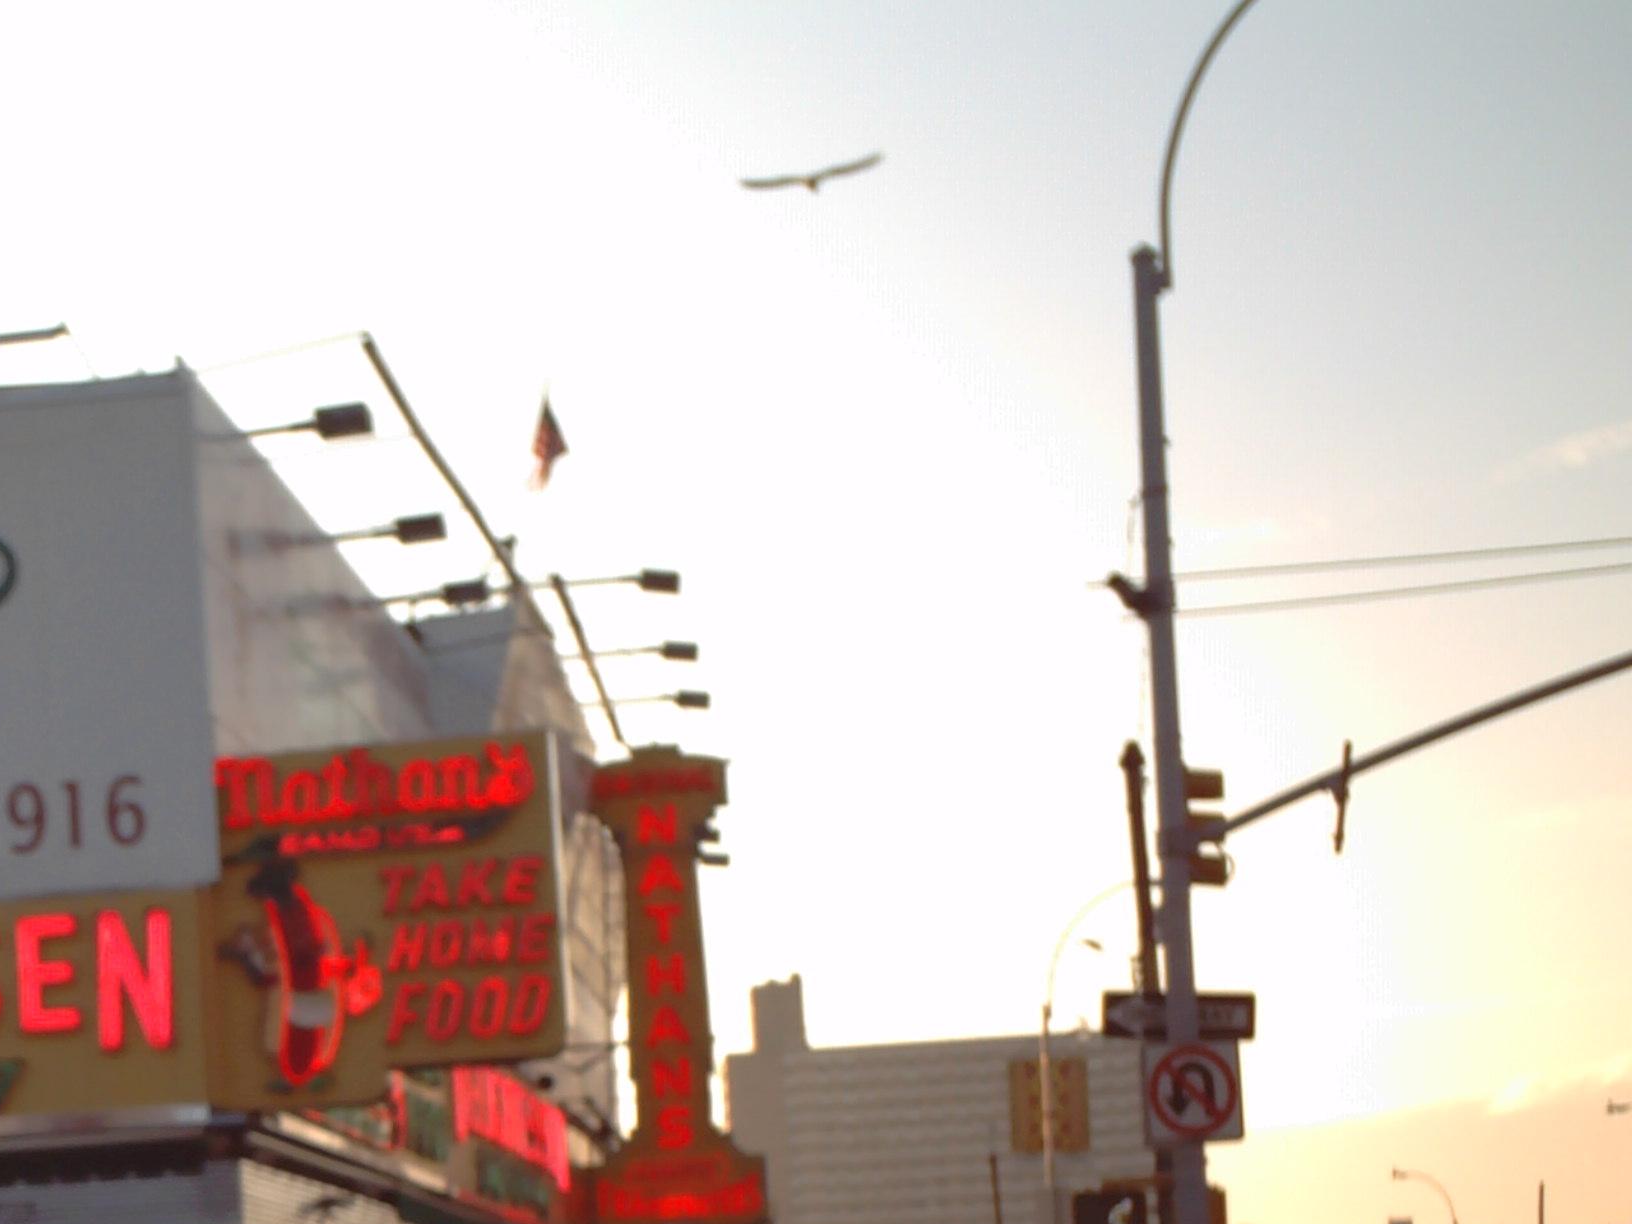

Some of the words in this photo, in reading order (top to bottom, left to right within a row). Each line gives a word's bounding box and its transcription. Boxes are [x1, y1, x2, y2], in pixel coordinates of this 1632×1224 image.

[379, 857, 544, 912] TAKE
[386, 914, 554, 972] HOME
[386, 975, 550, 1046] FOOD
